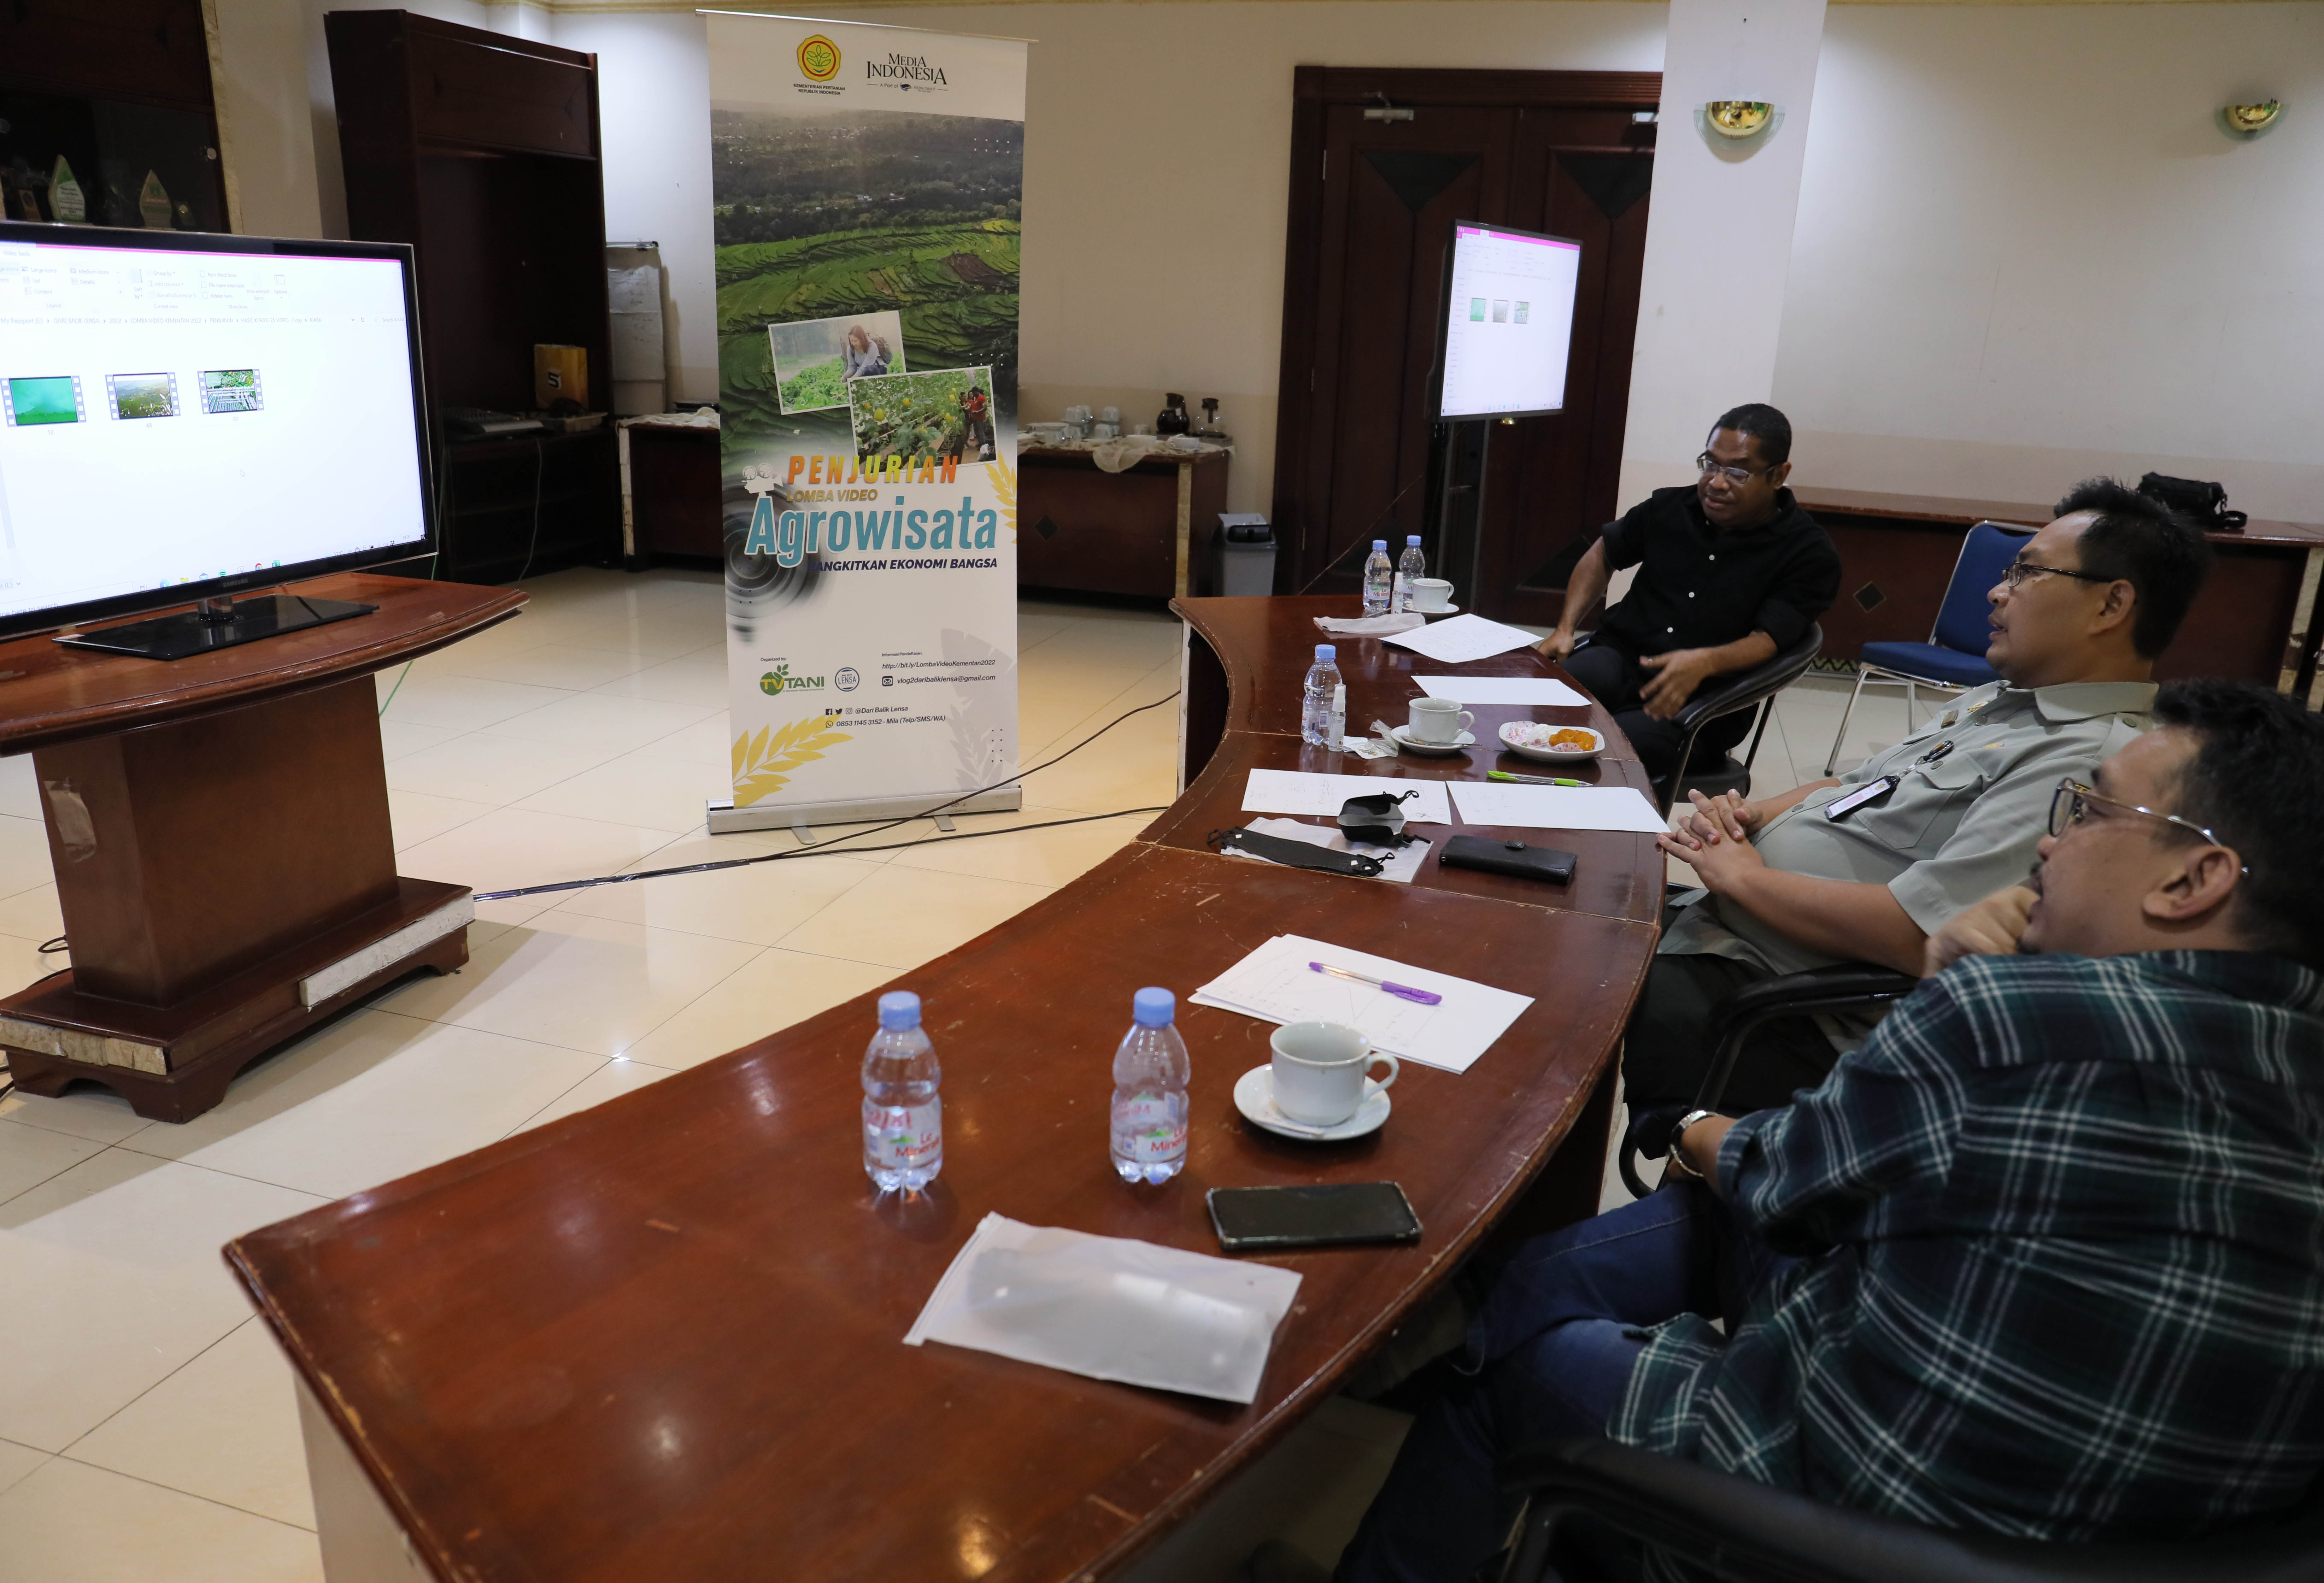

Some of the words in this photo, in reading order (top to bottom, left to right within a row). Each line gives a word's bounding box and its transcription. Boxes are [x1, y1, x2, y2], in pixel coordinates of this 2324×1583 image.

[888, 53, 927, 67] MEDIA
[867, 61, 947, 85] INDONESIA
[787, 455, 958, 484] PENJURIAN
[786, 490, 834, 502] LOMBA
[837, 489, 878, 501] VIDEO
[744, 495, 997, 567] Agrowisata
[808, 560, 887, 572] BANGKITKAN
[890, 558, 947, 570] EKONOMI
[950, 558, 997, 569] BANGSA
[37, 602, 58, 610] search
[882, 659, 996, 670] http://bit.ly/LombaVideoKementan2022
[838, 676, 857, 684] LENSA
[897, 675, 996, 684] vlog2daribaliklensa@gmail.com
[899, 715, 946, 724] (Telp/SMS/WA)
